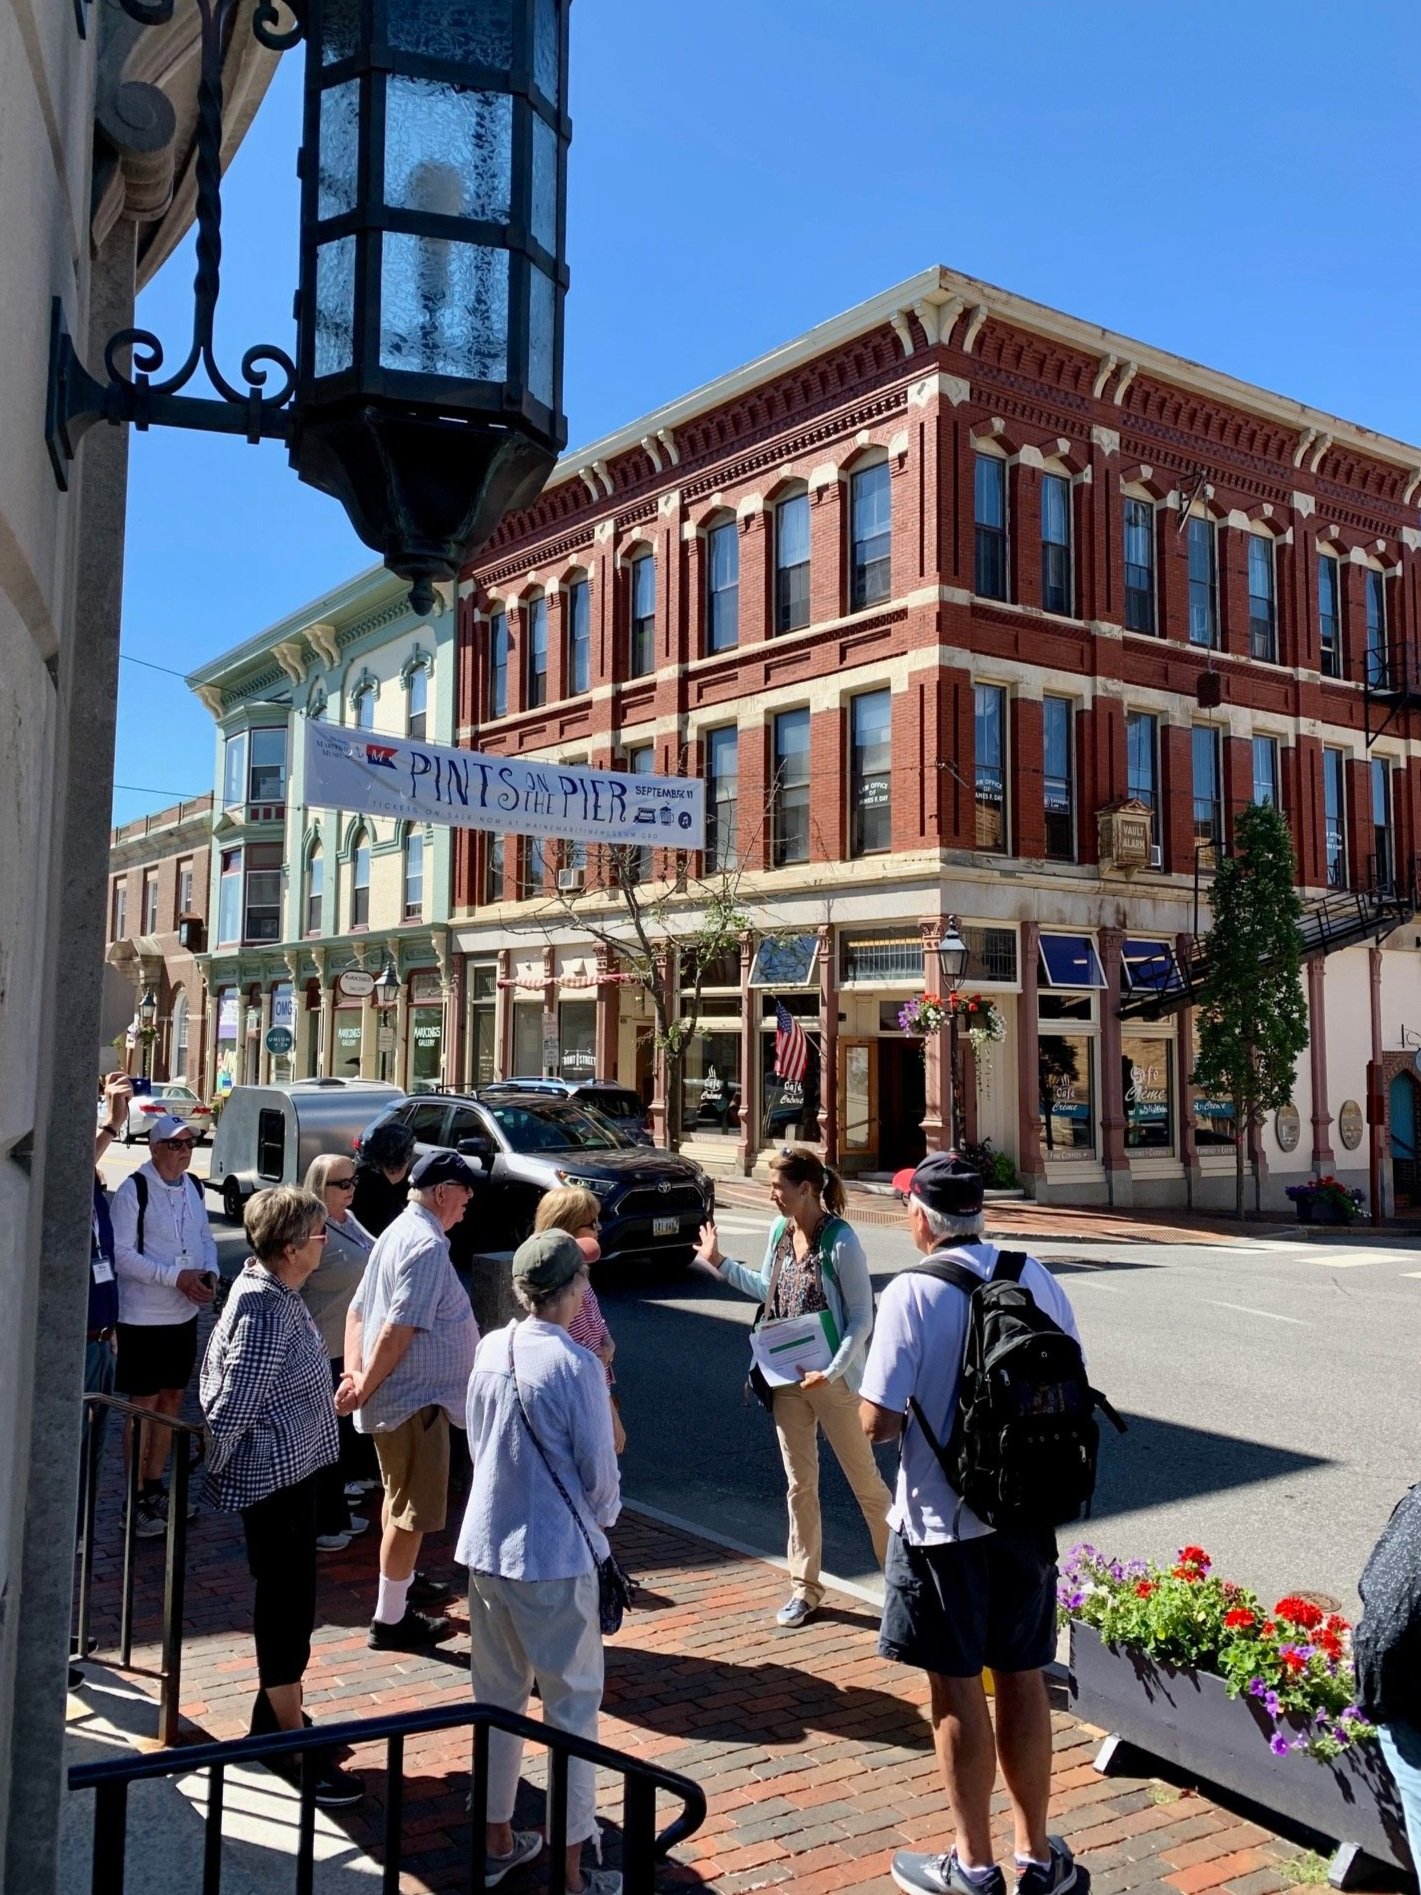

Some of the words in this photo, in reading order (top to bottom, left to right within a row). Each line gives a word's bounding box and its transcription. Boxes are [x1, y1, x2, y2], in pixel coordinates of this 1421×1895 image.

[410, 751, 520, 811] PINTS
[525, 771, 549, 793] ON
[870, 782, 888, 790] OFFICE
[984, 779, 1003, 790] OFFICE
[558, 775, 626, 823] PIER
[635, 785, 685, 799] SEPTEMBER
[523, 791, 555, 815] THE
[373, 801, 418, 814] TICKETS
[425, 808, 440, 817] ON
[448, 812, 472, 820] SALE
[479, 816, 500, 825] NOW
[1122, 825, 1144, 837] VAULT
[1122, 838, 1145, 849] ALARM
[276, 1001, 292, 1016] OMG
[414, 1026, 440, 1039] MARKINGS
[418, 1039, 435, 1047] GALLERY
